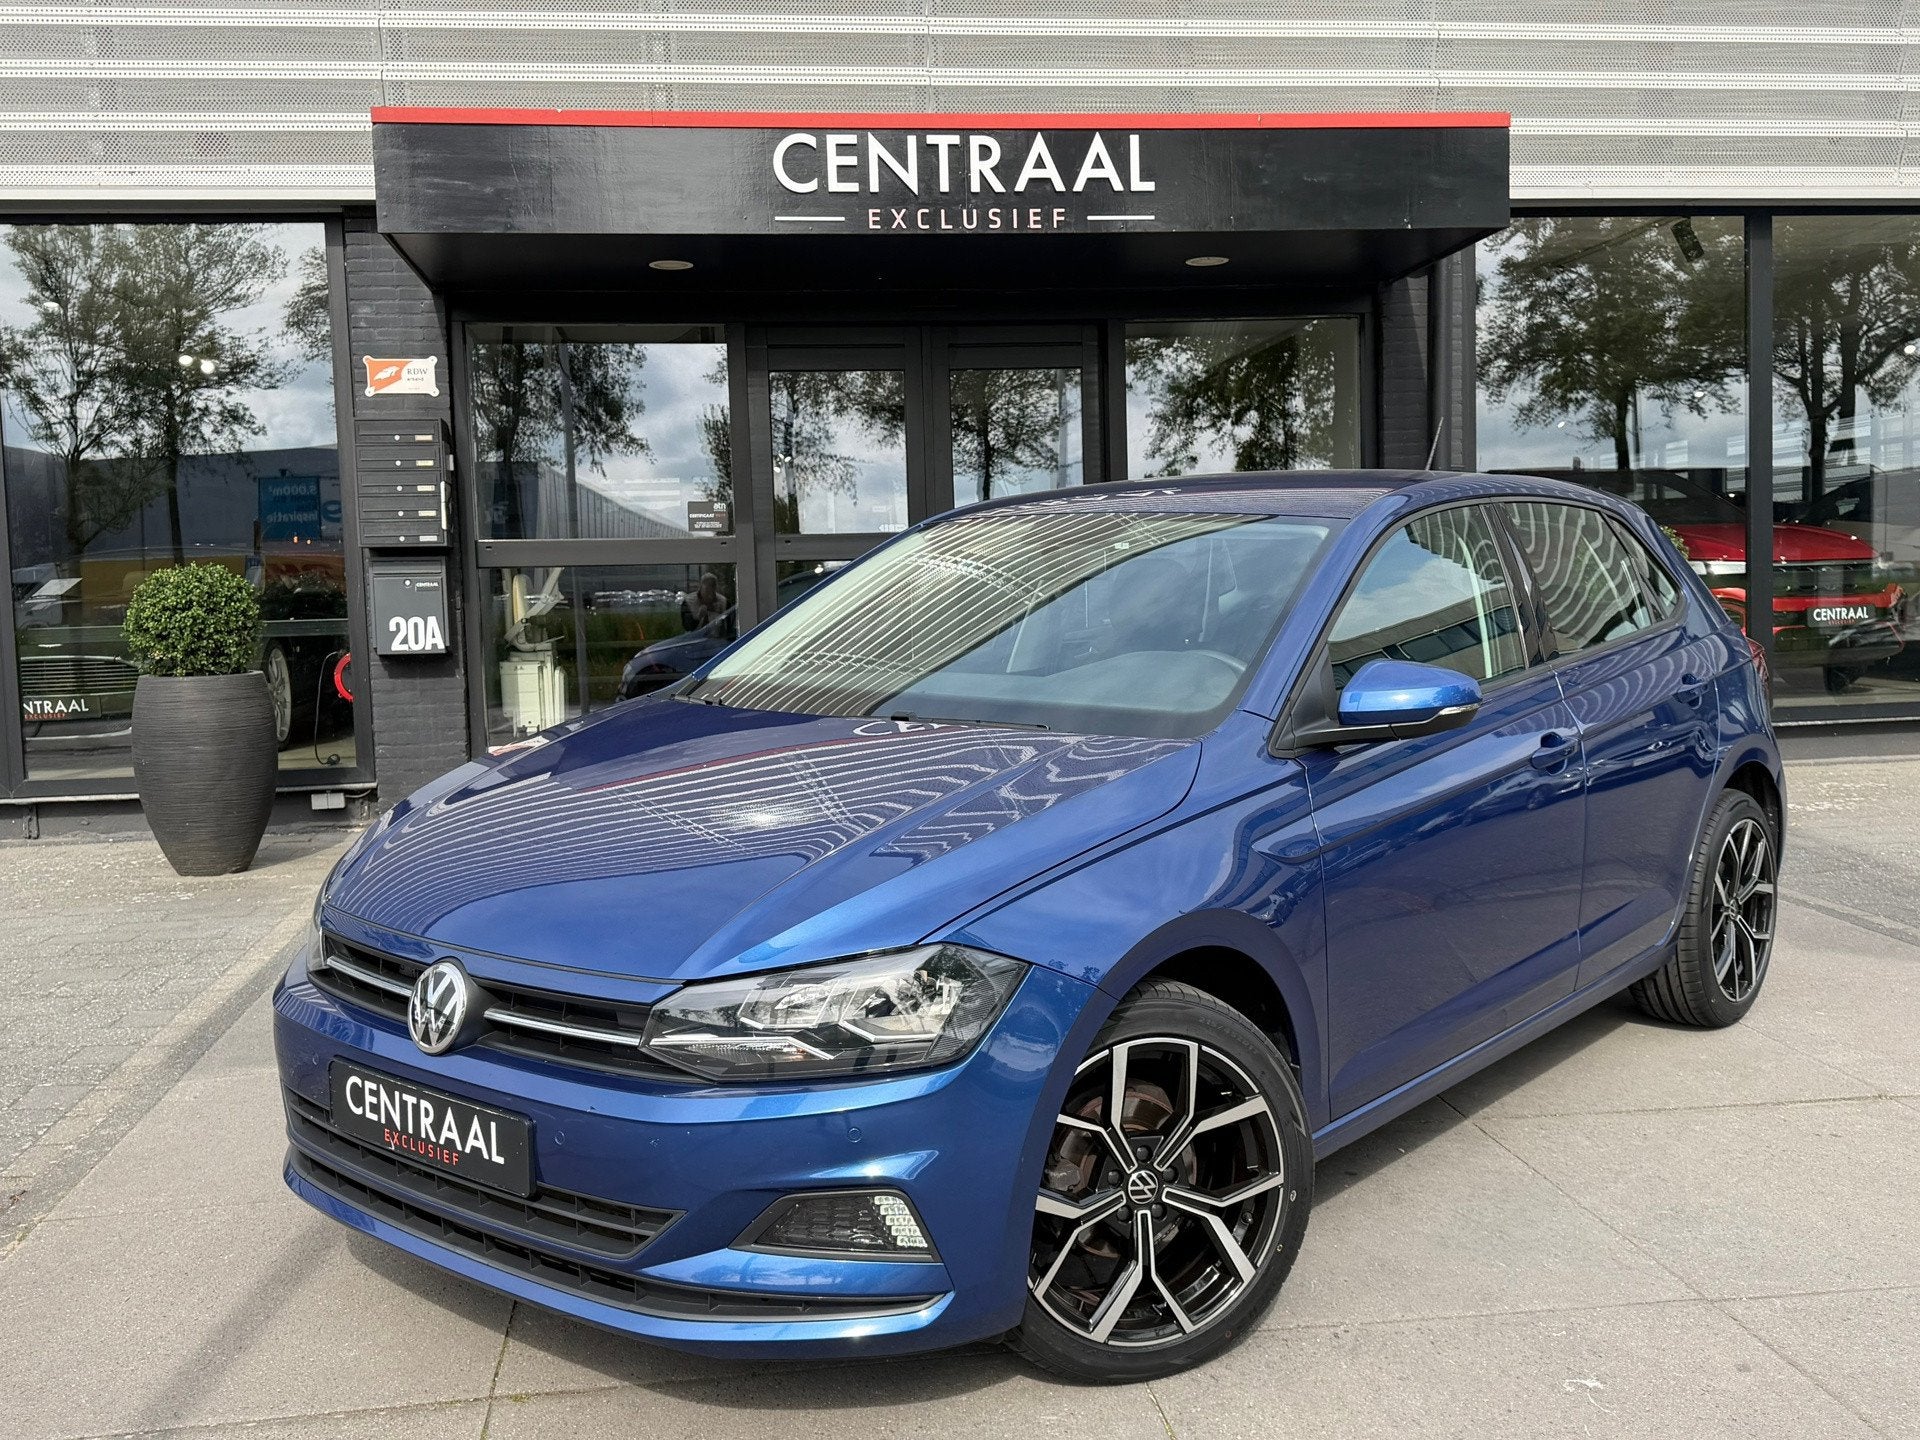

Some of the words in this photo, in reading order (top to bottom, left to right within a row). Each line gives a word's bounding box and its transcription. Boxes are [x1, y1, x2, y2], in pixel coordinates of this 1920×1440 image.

[772, 132, 1156, 195] CENTRAAL
[868, 208, 1067, 230] EXCLUSIEF
[1813, 606, 1869, 621] CENTRAAL
[389, 615, 445, 651] 20A
[345, 1075, 505, 1165] CENTRAAL
[384, 1128, 459, 1166] EXCLUSIEF
